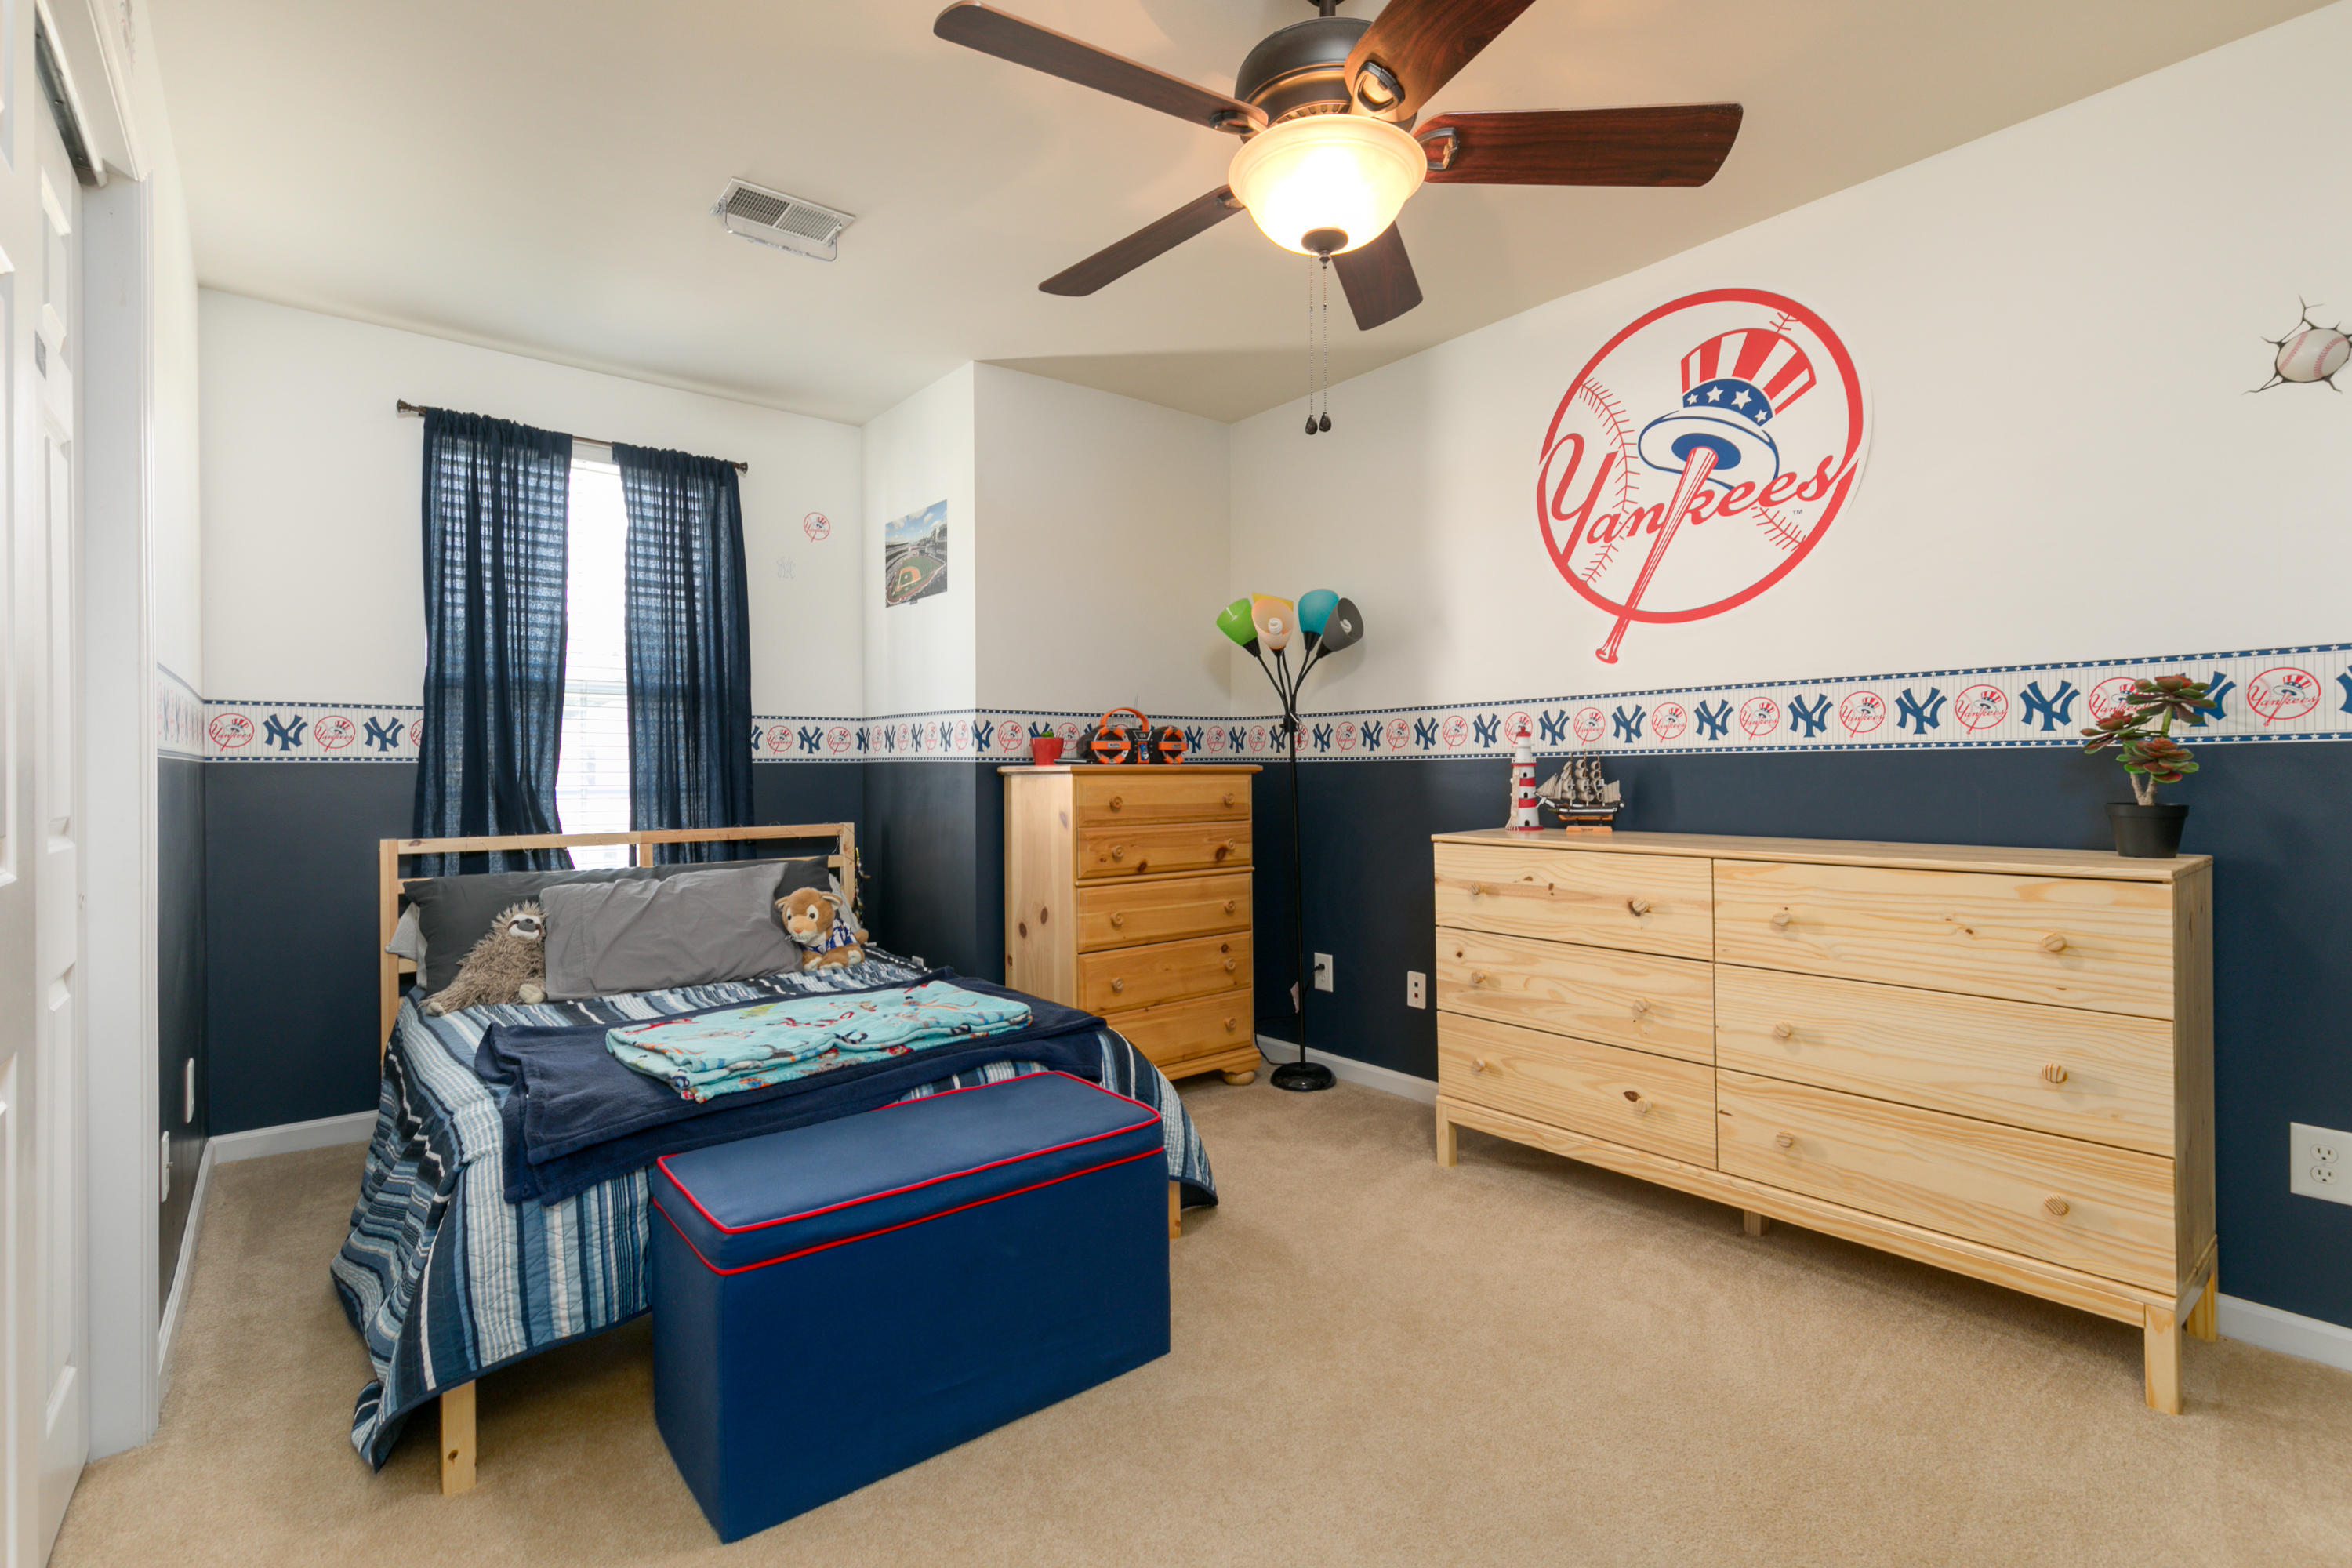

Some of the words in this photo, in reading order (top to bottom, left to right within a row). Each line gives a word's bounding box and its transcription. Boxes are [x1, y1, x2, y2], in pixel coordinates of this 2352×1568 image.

[1551, 433, 1836, 566] Yankees
[263, 713, 308, 751] NY
[363, 716, 405, 752] NY
[797, 725, 823, 754] NY
[1360, 720, 1384, 752] NY
[1414, 717, 1439, 750] NY
[1472, 713, 1501, 748] NY
[1538, 709, 1570, 746] NY
[1611, 704, 1647, 743] NY
[1693, 699, 1734, 741] NY
[1788, 693, 1834, 738] NY
[1894, 686, 1947, 735] NY
[2018, 680, 2081, 731] NY
[2249, 685, 2318, 709] Yankees
